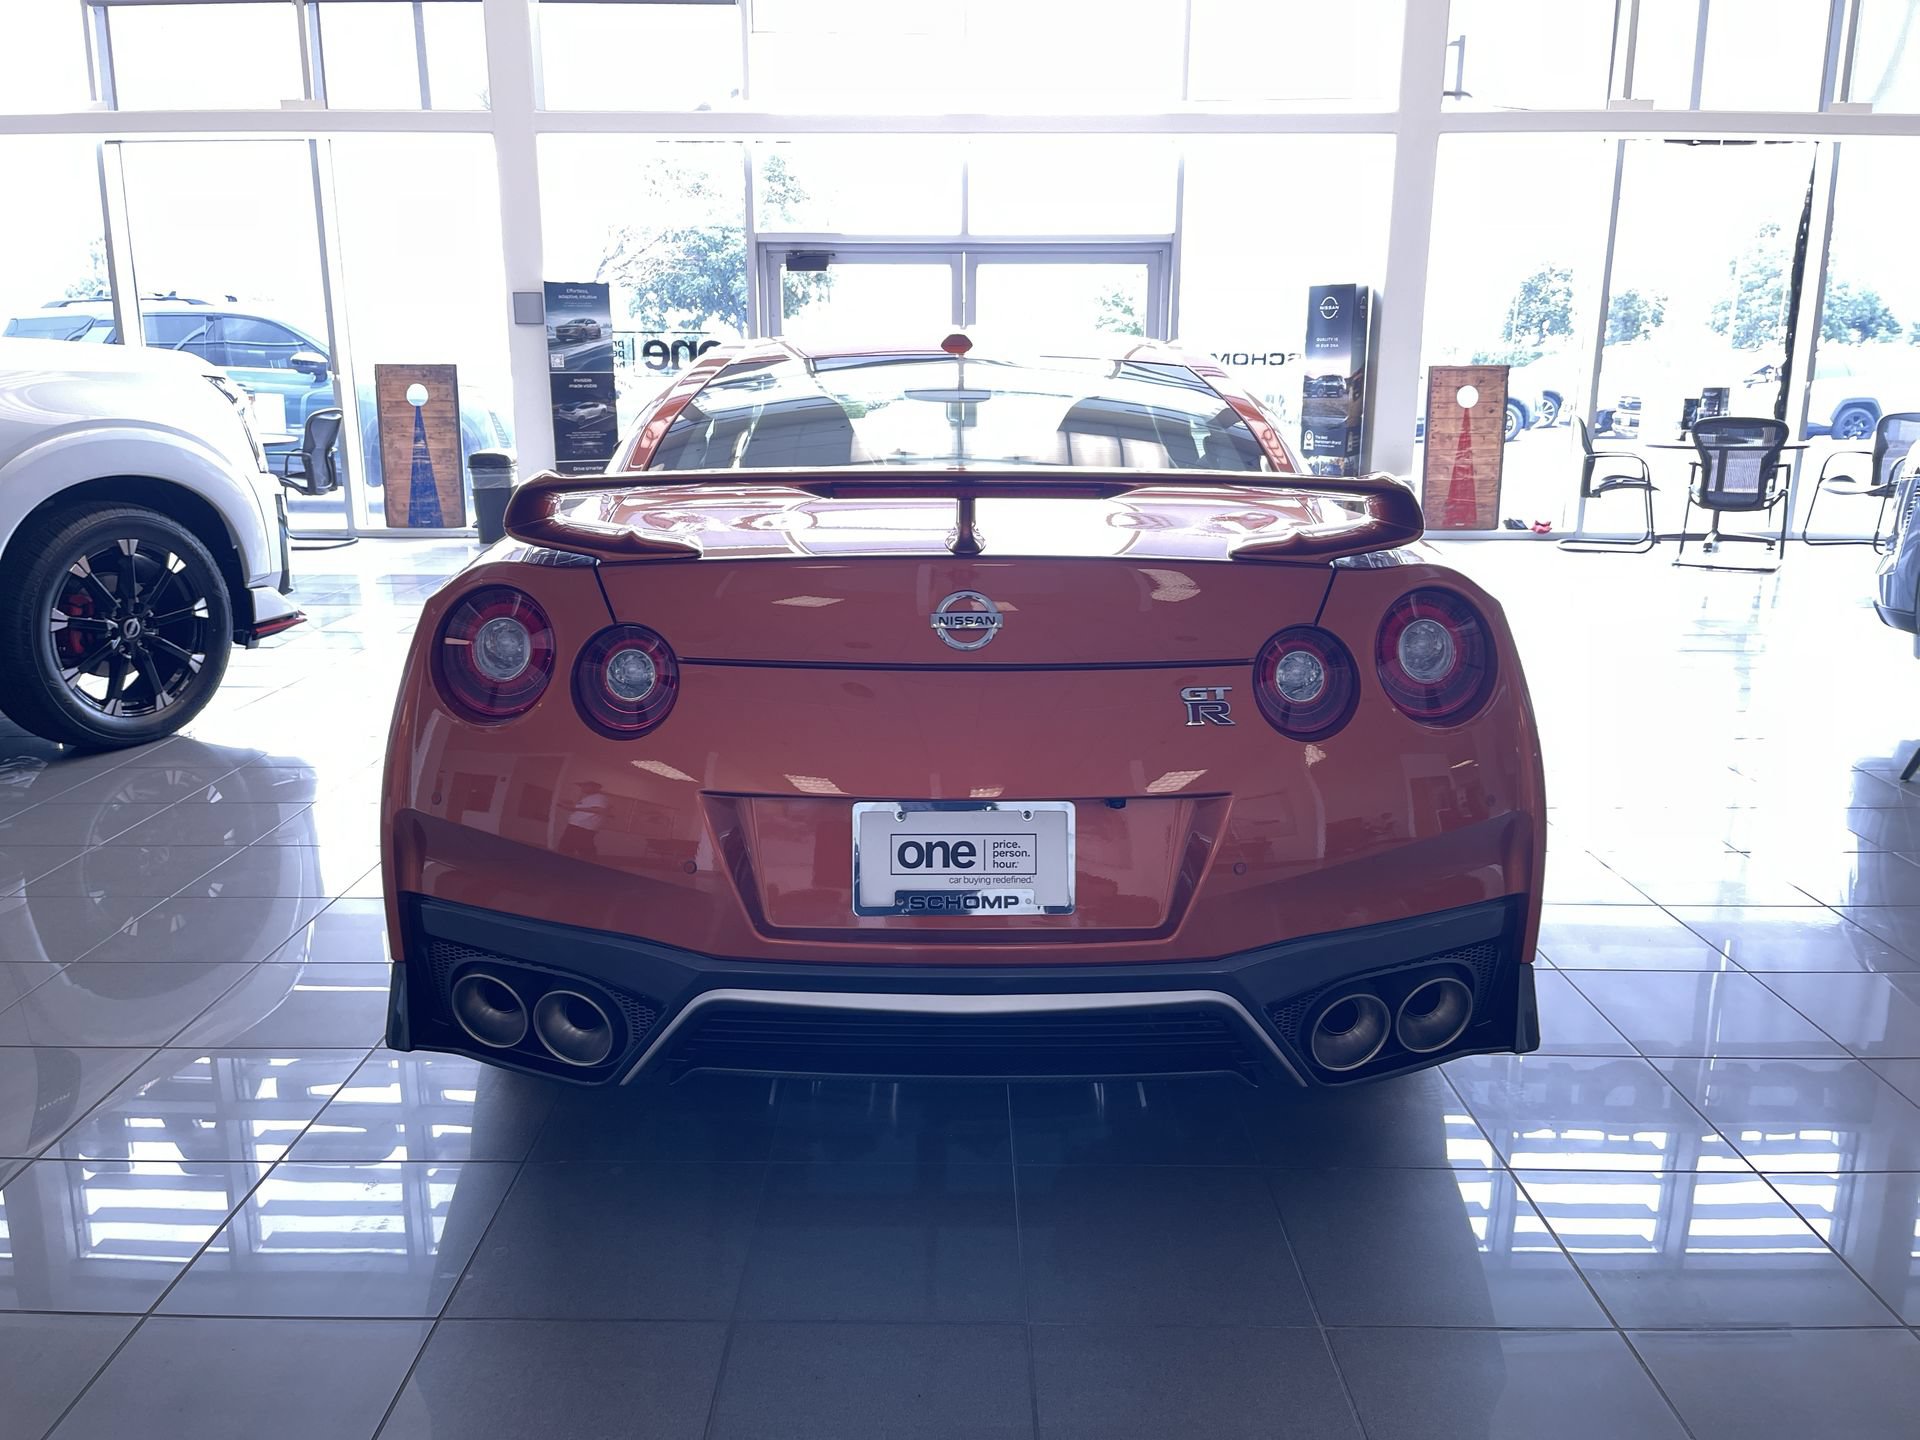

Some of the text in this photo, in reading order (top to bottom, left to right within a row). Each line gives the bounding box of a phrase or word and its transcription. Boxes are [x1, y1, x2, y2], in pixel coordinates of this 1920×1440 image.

[938, 616, 995, 625] NISSAN
[992, 839, 1021, 850] price.
[897, 840, 977, 869] one
[992, 850, 1031, 859] person.
[963, 875, 991, 886] buying
[908, 895, 1020, 909] SCHOMP
